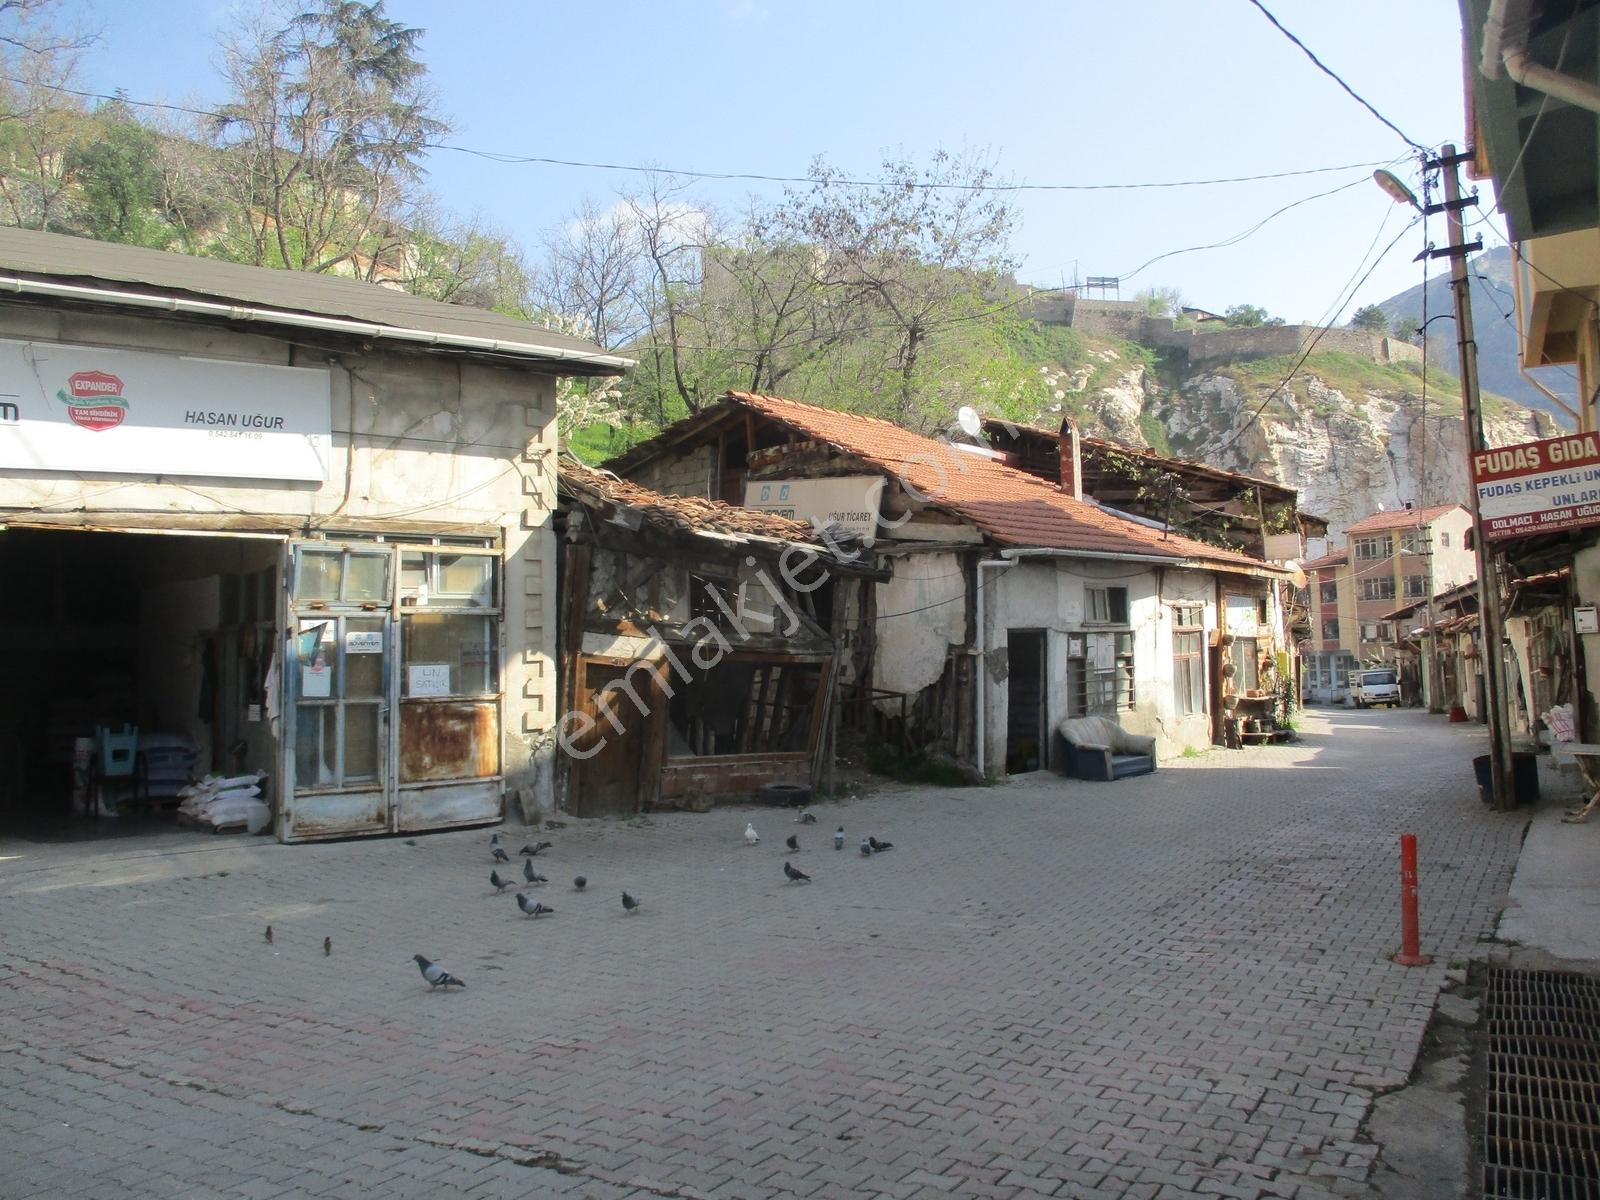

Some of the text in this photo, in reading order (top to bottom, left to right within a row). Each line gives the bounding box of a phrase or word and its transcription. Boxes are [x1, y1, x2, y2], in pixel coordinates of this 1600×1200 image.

[75, 380, 118, 393] EXPANDER
[184, 410, 285, 429] HASAN UĞUR
[1474, 436, 1598, 476] FUDAŞ GIDA
[1491, 515, 1534, 530] DOLMACI
[1540, 509, 1572, 523] HASAN
